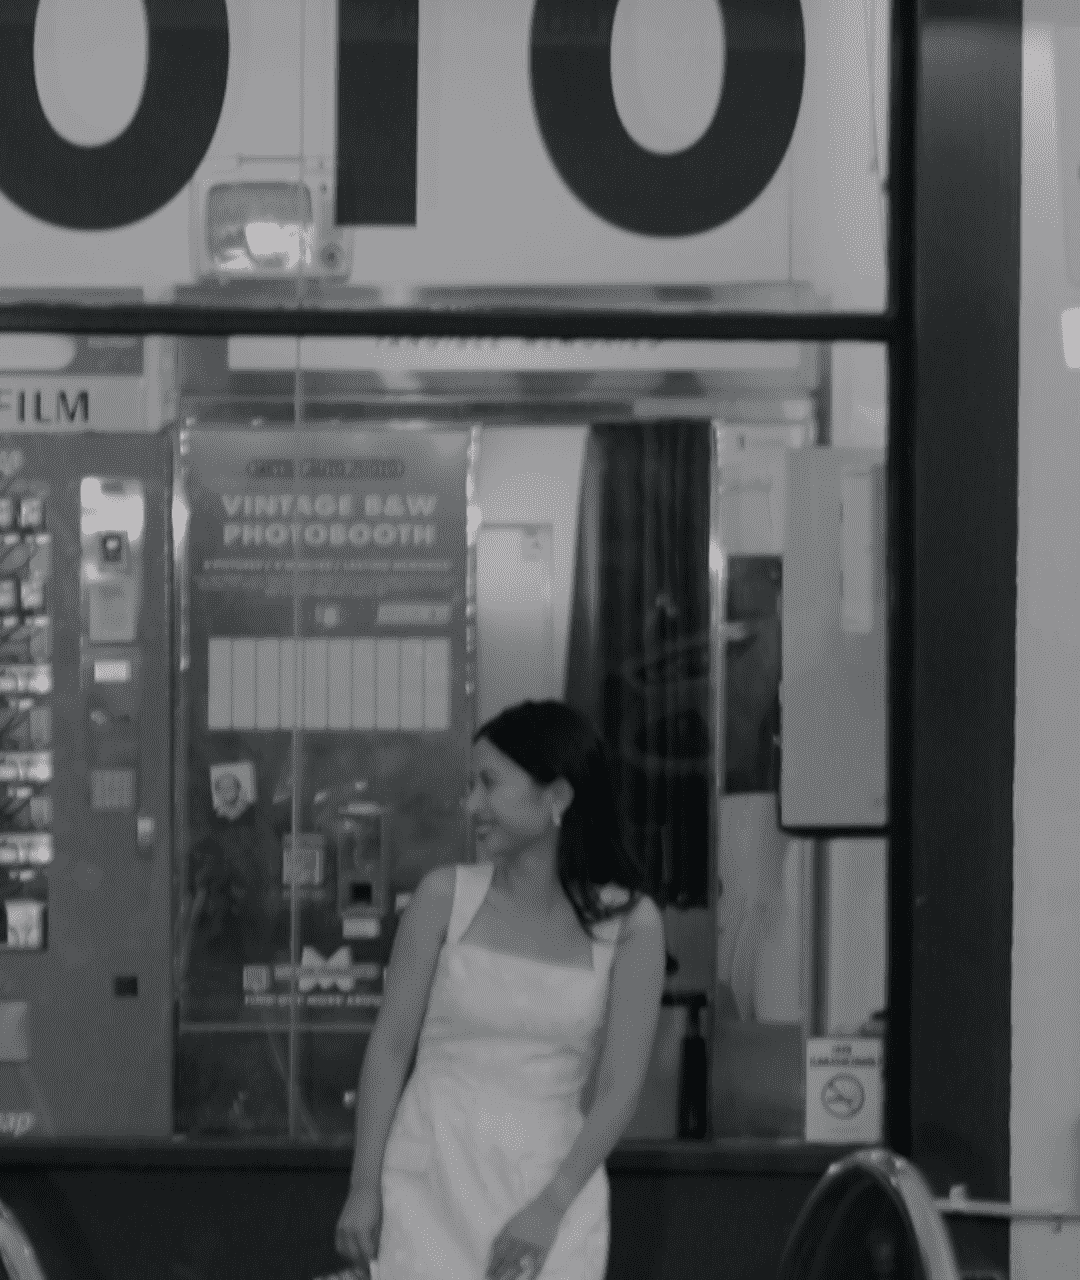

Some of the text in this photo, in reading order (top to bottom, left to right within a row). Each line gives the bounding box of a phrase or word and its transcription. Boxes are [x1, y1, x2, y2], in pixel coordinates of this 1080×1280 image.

[221, 493, 438, 517] VINTAGE B&W
[222, 523, 436, 548] PHOTOBOOTH
